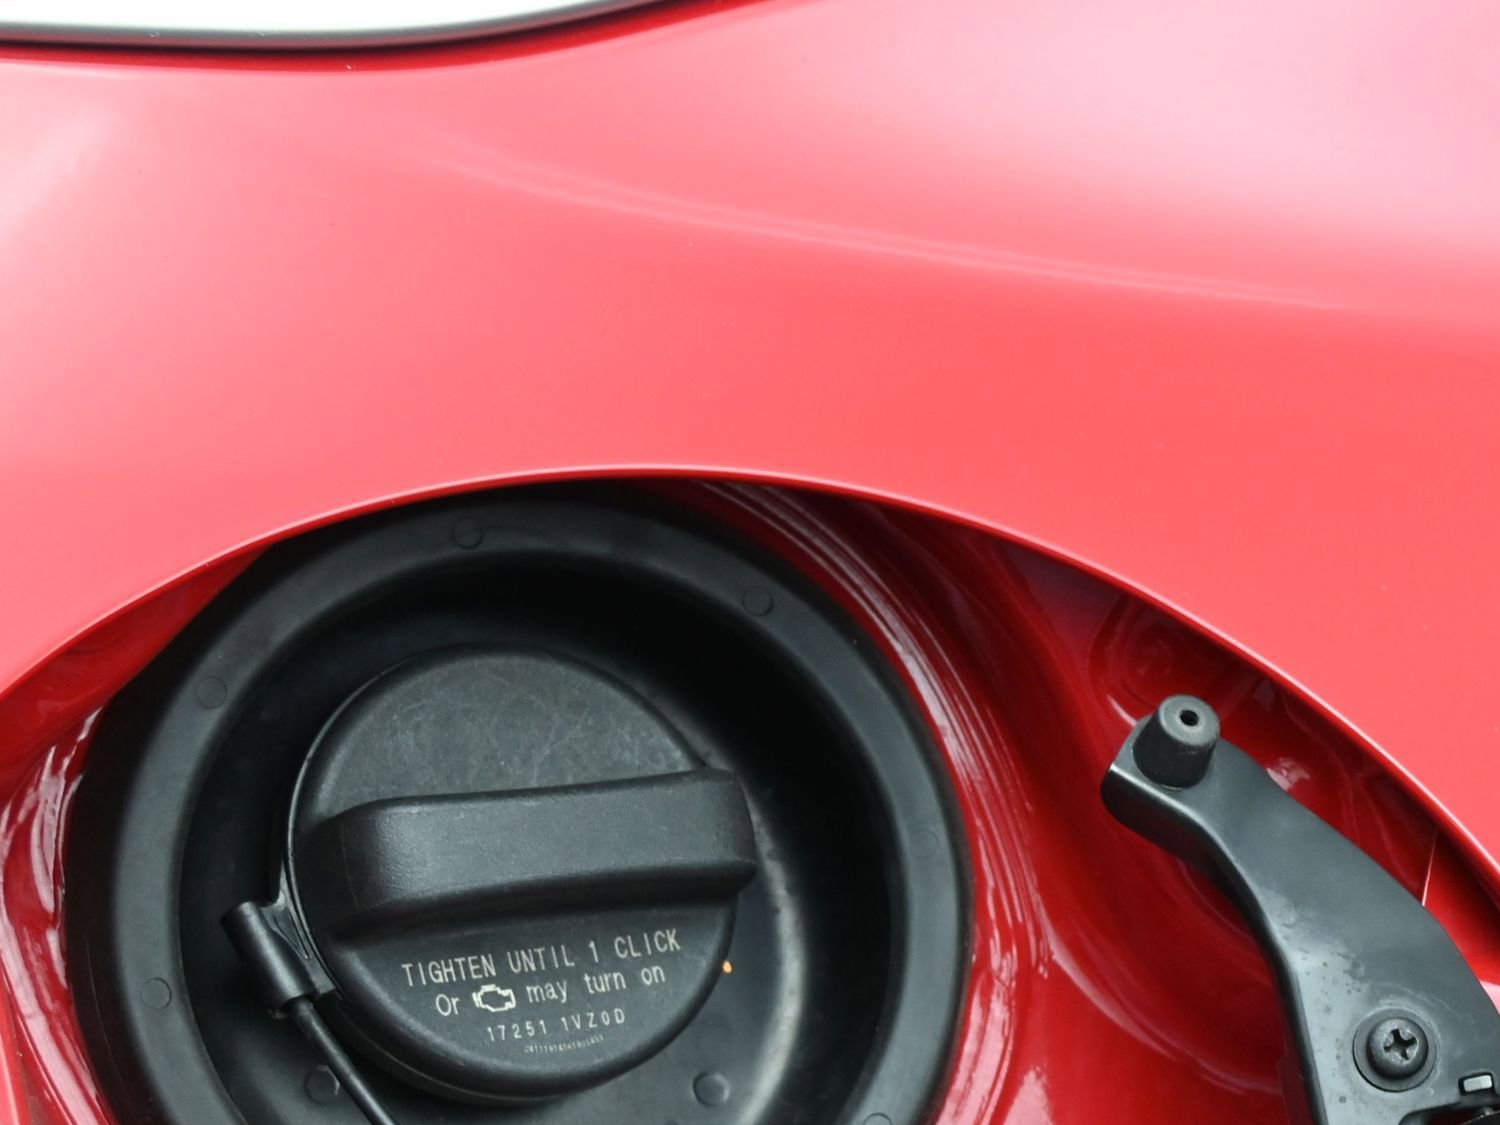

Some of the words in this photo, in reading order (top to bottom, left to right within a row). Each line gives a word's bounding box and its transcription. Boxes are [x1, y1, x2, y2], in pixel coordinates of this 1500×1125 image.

[401, 954, 497, 987] TIGHTEN
[507, 944, 575, 974] UNTIL
[588, 941, 599, 962] 1
[614, 929, 681, 959] CLICK
[435, 994, 459, 1016] Or
[526, 979, 568, 1004] may
[584, 971, 626, 994] turn
[641, 964, 665, 986] on
[487, 1019, 548, 1042] 17251
[561, 1008, 625, 1031] 1VZ0D
